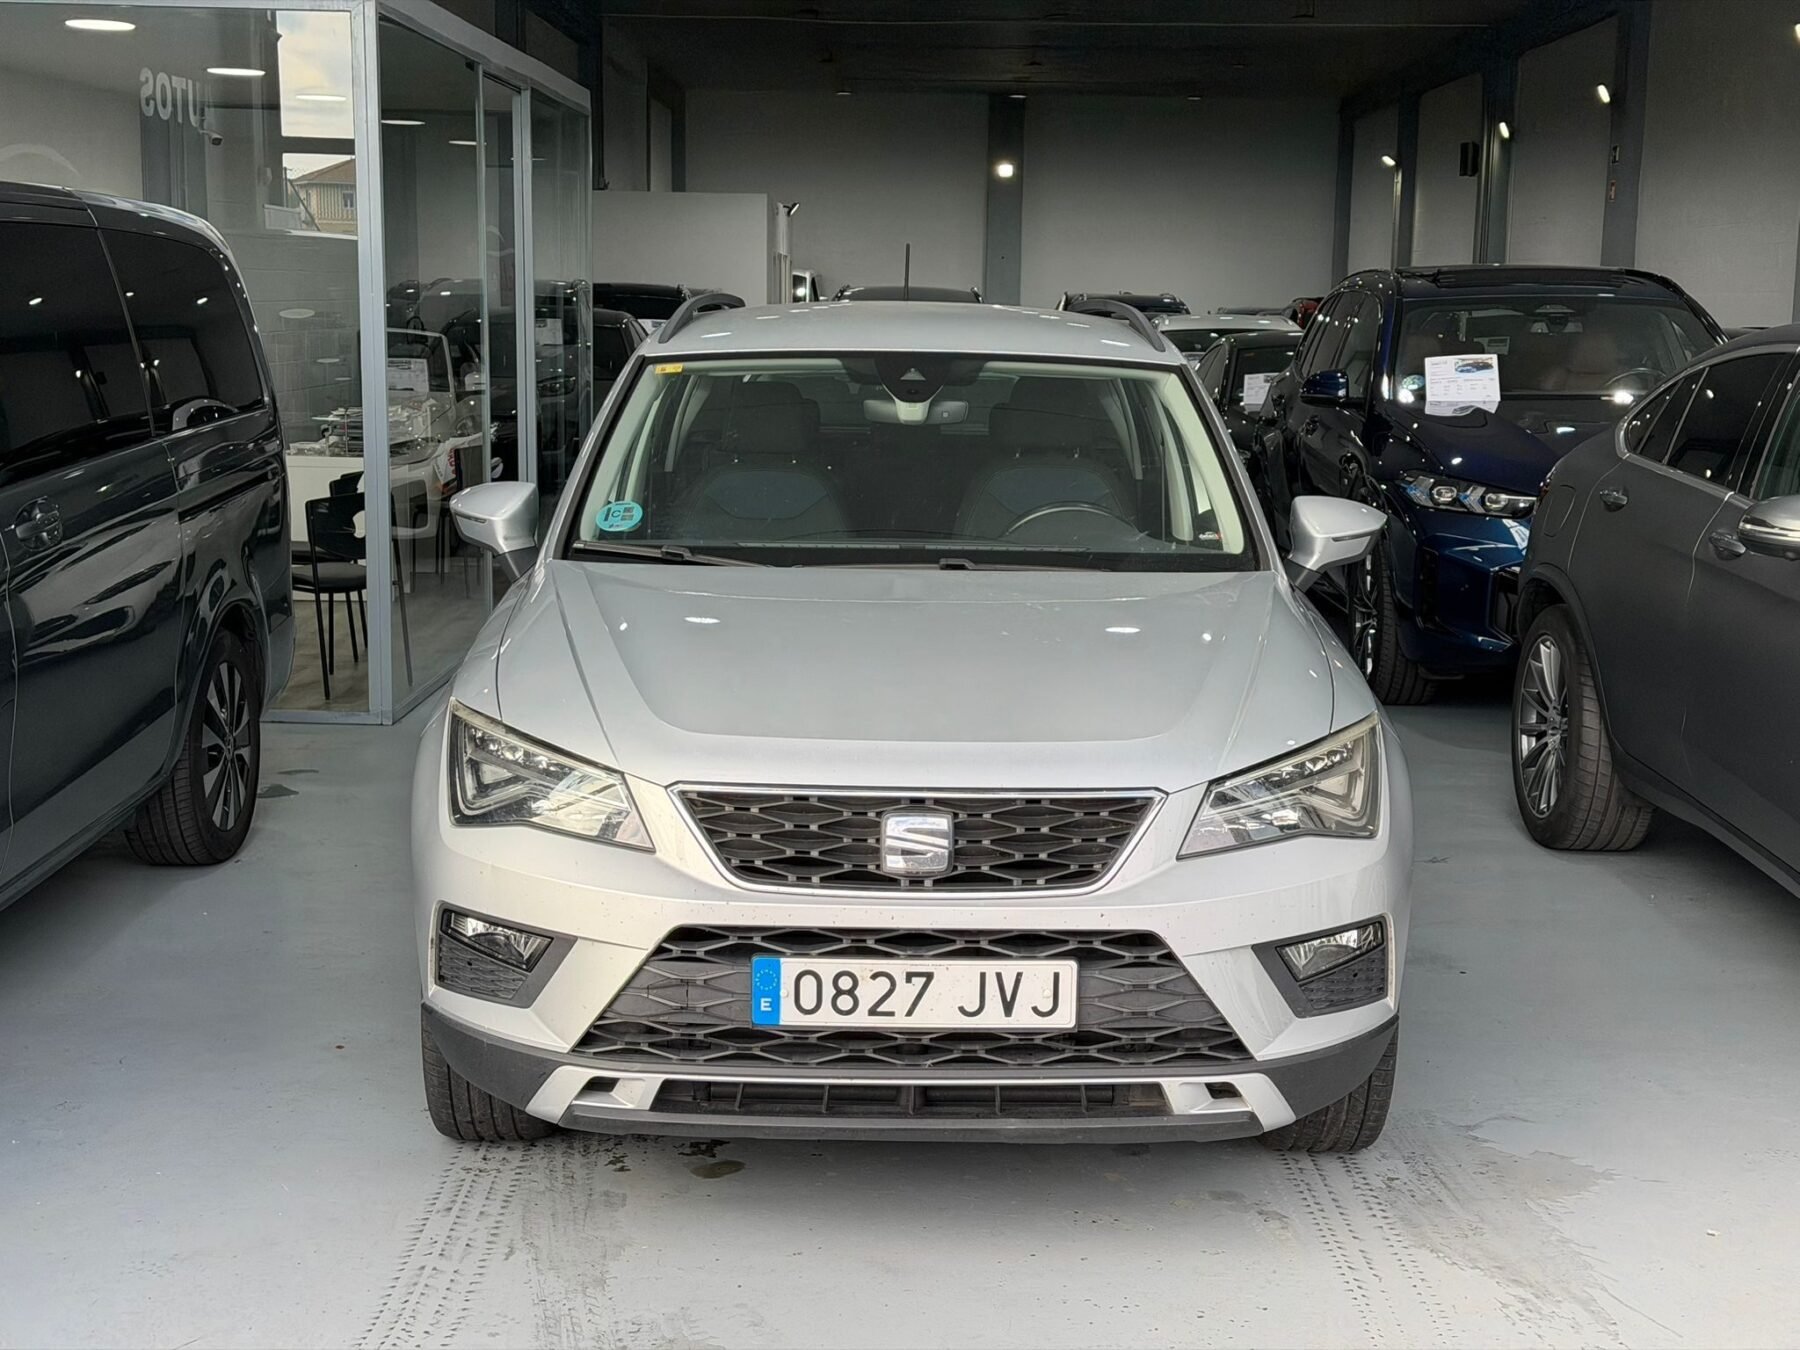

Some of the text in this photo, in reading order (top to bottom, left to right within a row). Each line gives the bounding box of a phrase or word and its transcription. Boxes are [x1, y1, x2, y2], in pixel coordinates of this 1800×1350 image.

[760, 998, 772, 1011] E
[793, 968, 1060, 1018] 0827 JVJ
